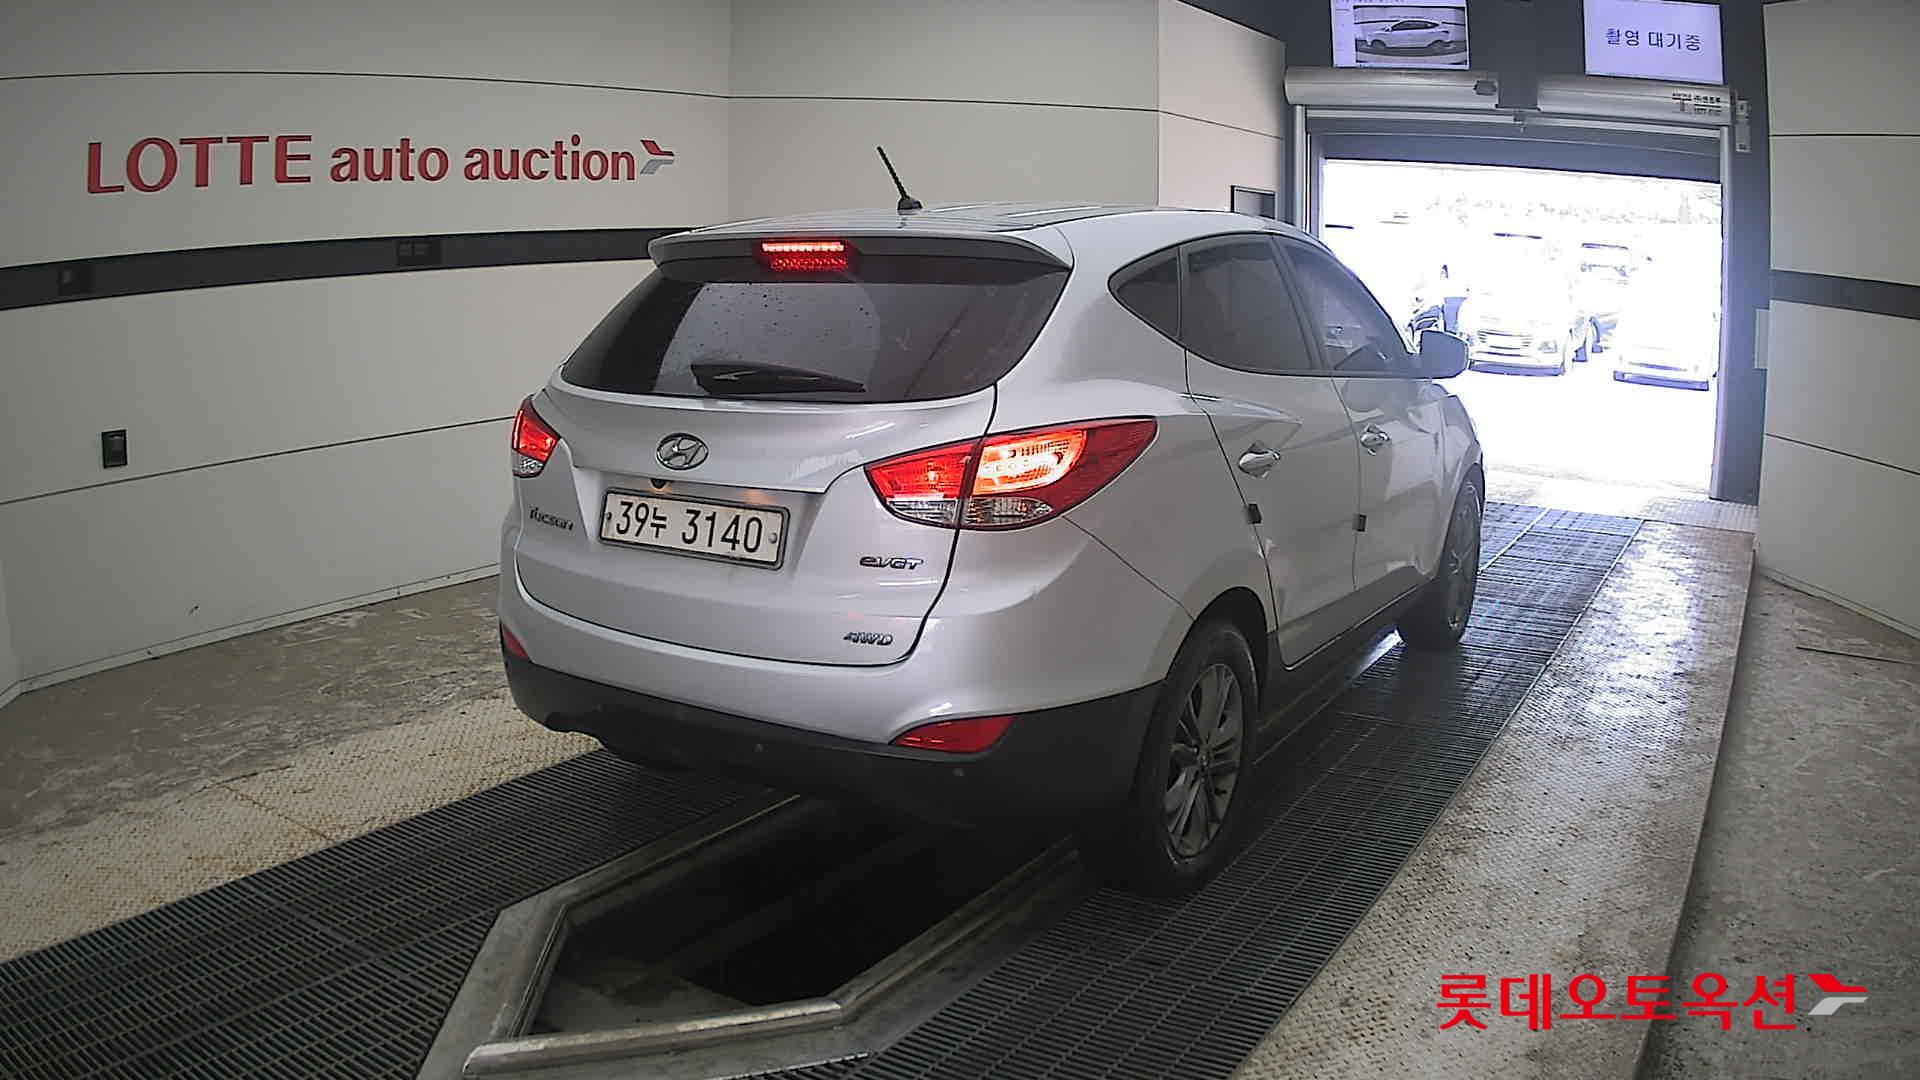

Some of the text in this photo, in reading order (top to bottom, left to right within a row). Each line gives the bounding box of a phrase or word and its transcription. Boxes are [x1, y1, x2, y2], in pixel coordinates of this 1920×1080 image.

[1648, 31, 1701, 51] 대기중
[88, 134, 637, 194] LOTTE auto auction
[616, 501, 760, 553] 39누 3140
[843, 632, 893, 646] 4WD
